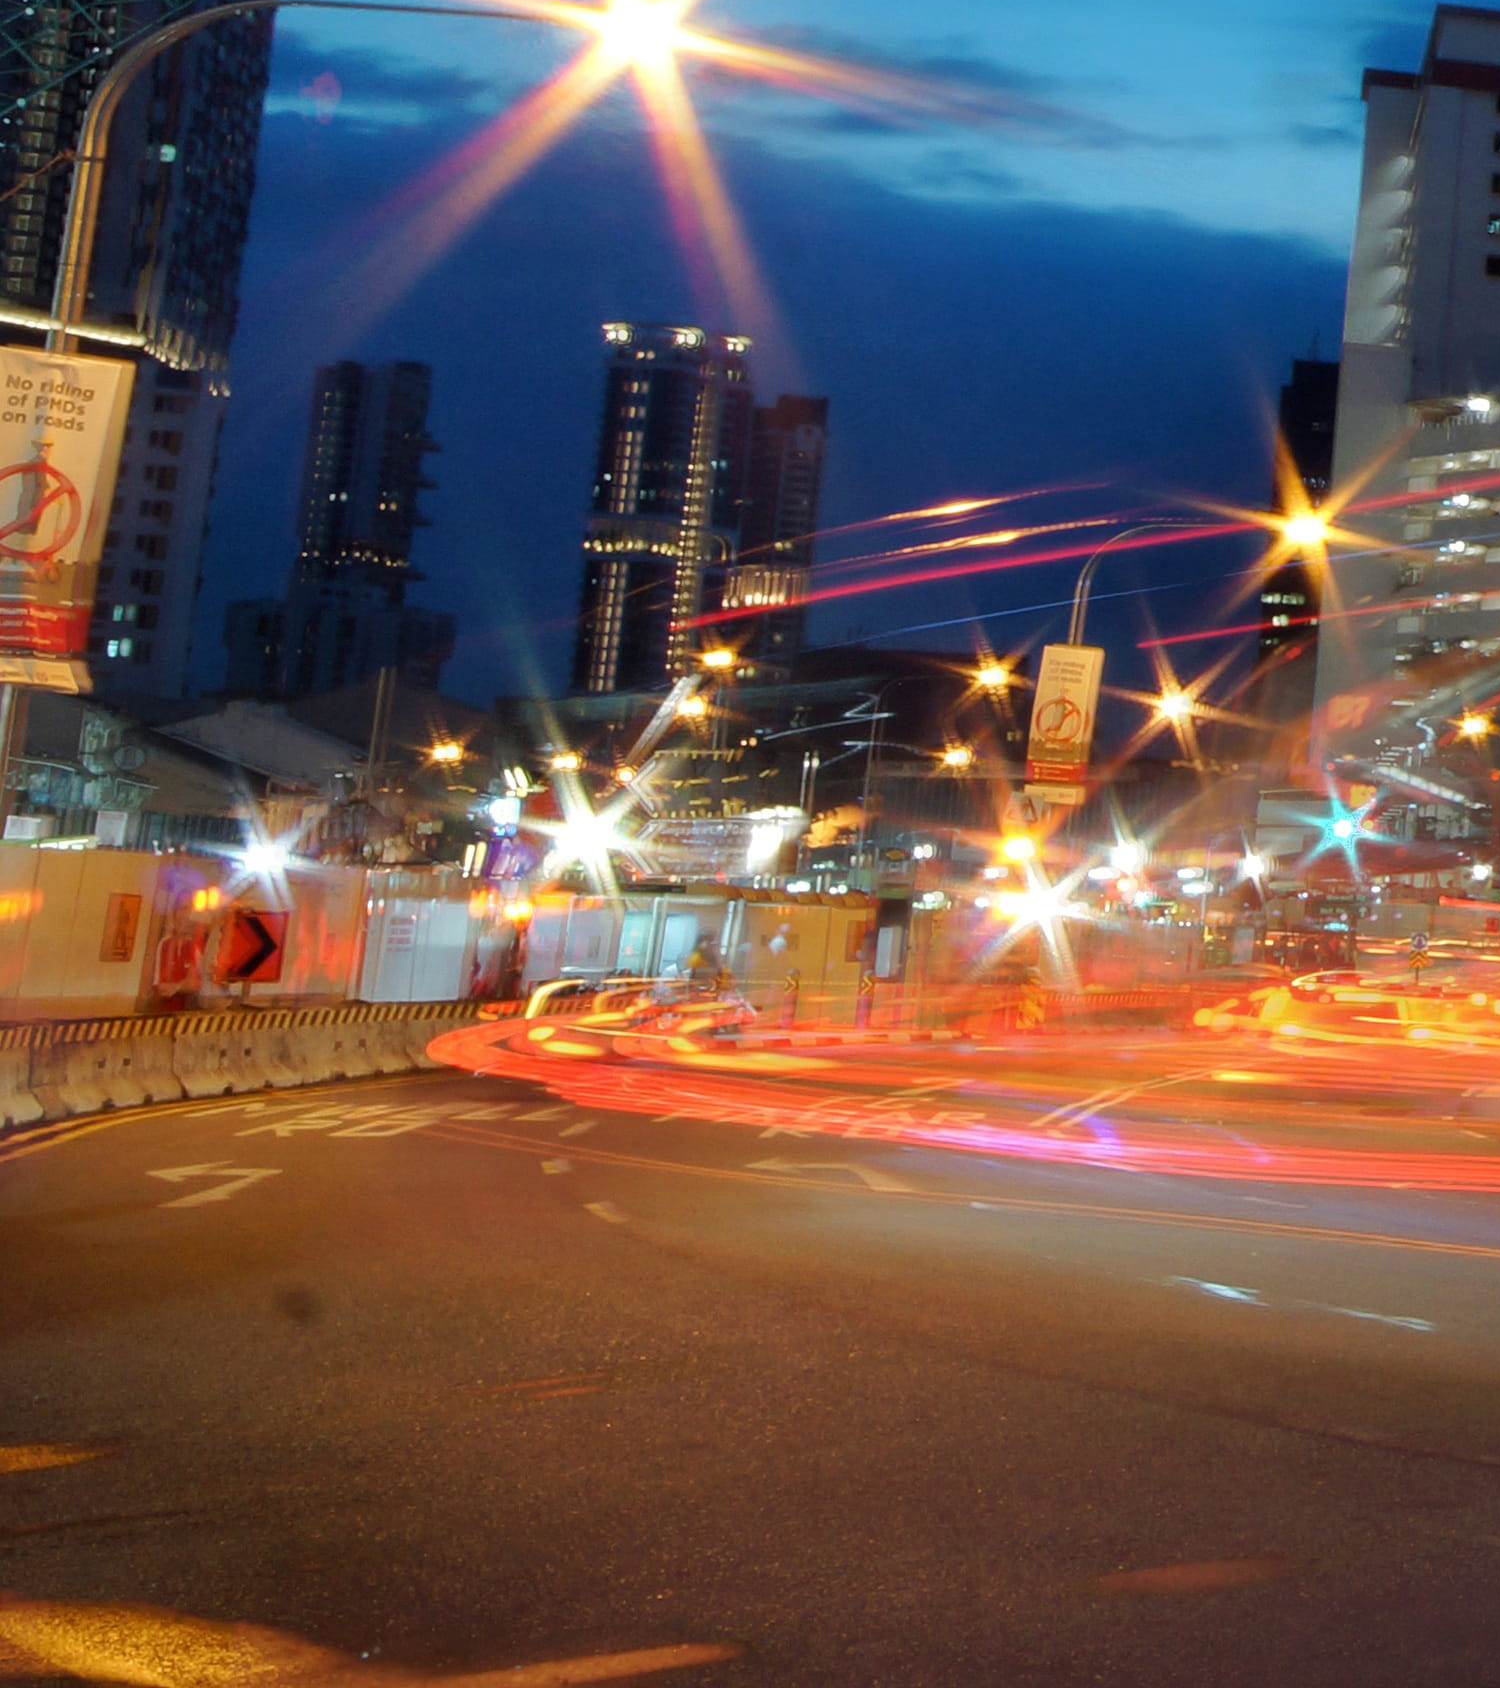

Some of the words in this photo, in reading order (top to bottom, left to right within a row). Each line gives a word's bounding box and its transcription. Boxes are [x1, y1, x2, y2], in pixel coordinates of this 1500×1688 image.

[6, 374, 33, 390] No
[40, 379, 95, 402] riding
[8, 393, 28, 408] of
[35, 396, 86, 416] PMDs
[2, 411, 26, 424] on
[35, 415, 85, 431] roads
